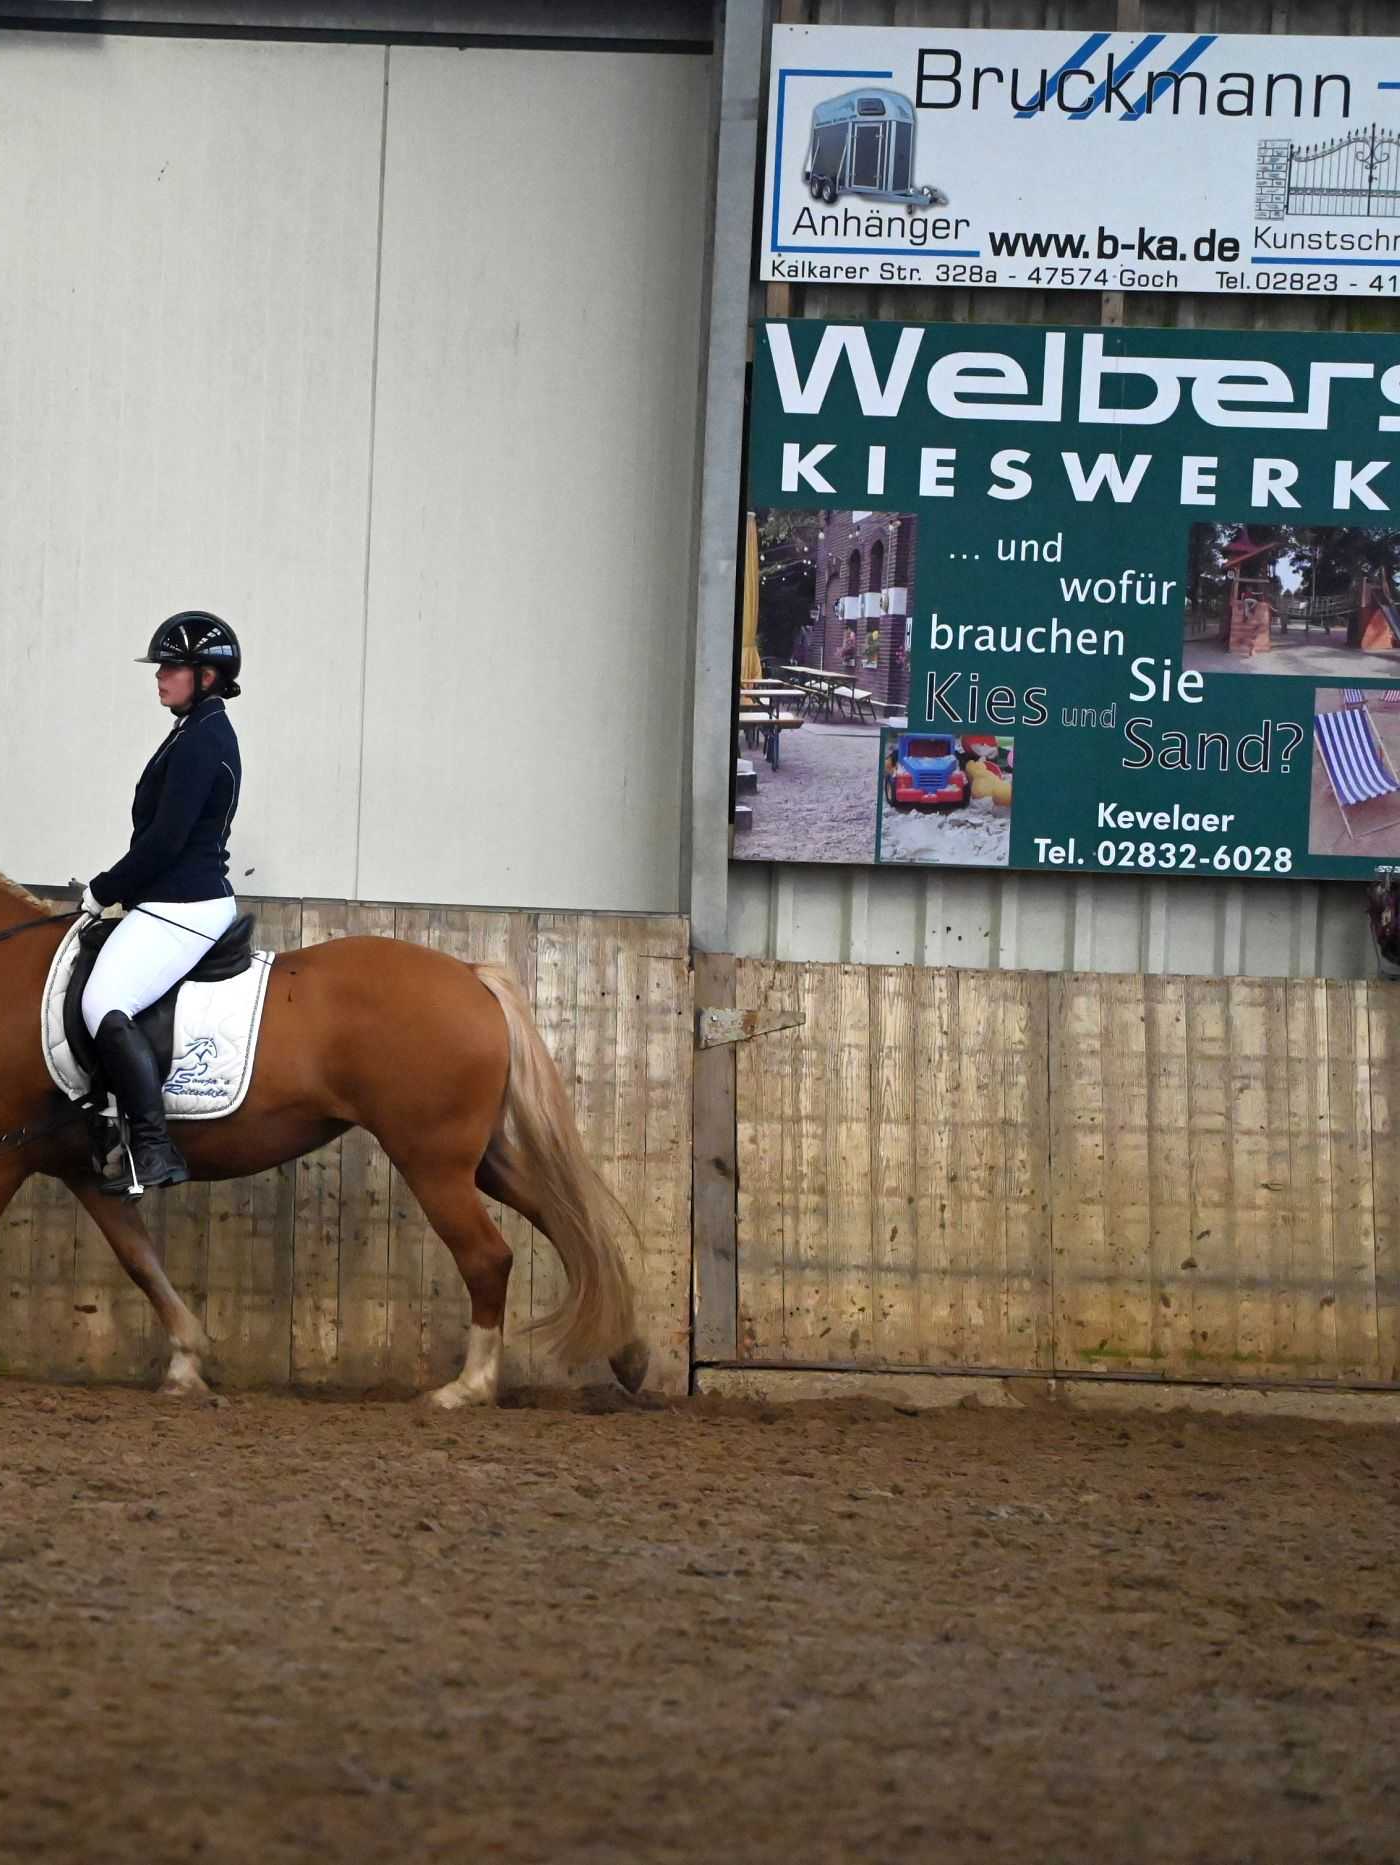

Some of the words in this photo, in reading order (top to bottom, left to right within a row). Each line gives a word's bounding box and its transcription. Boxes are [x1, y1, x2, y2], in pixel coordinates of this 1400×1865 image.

[915, 45, 1350, 118] Bruckmann
[792, 207, 971, 246] Anhänger
[988, 225, 1240, 263] www.b-ka.de
[771, 259, 870, 280] Kalkarer
[879, 262, 922, 281] Str.
[935, 263, 997, 284] 328a
[1023, 266, 1109, 289] 47574
[1119, 268, 1178, 289] Goch
[781, 442, 1392, 512] KIESWERK
[997, 532, 1063, 563] und
[1059, 569, 1177, 605] wofür
[930, 613, 1124, 656] brauchen
[925, 670, 1049, 727] Kies
[1061, 701, 1117, 729] und
[1129, 657, 1204, 704] Sie
[1121, 716, 1304, 774] Sand?
[1097, 802, 1235, 832] Kevelaer
[1033, 837, 1084, 865] Tel.
[1097, 840, 1293, 873] 02832-6028
